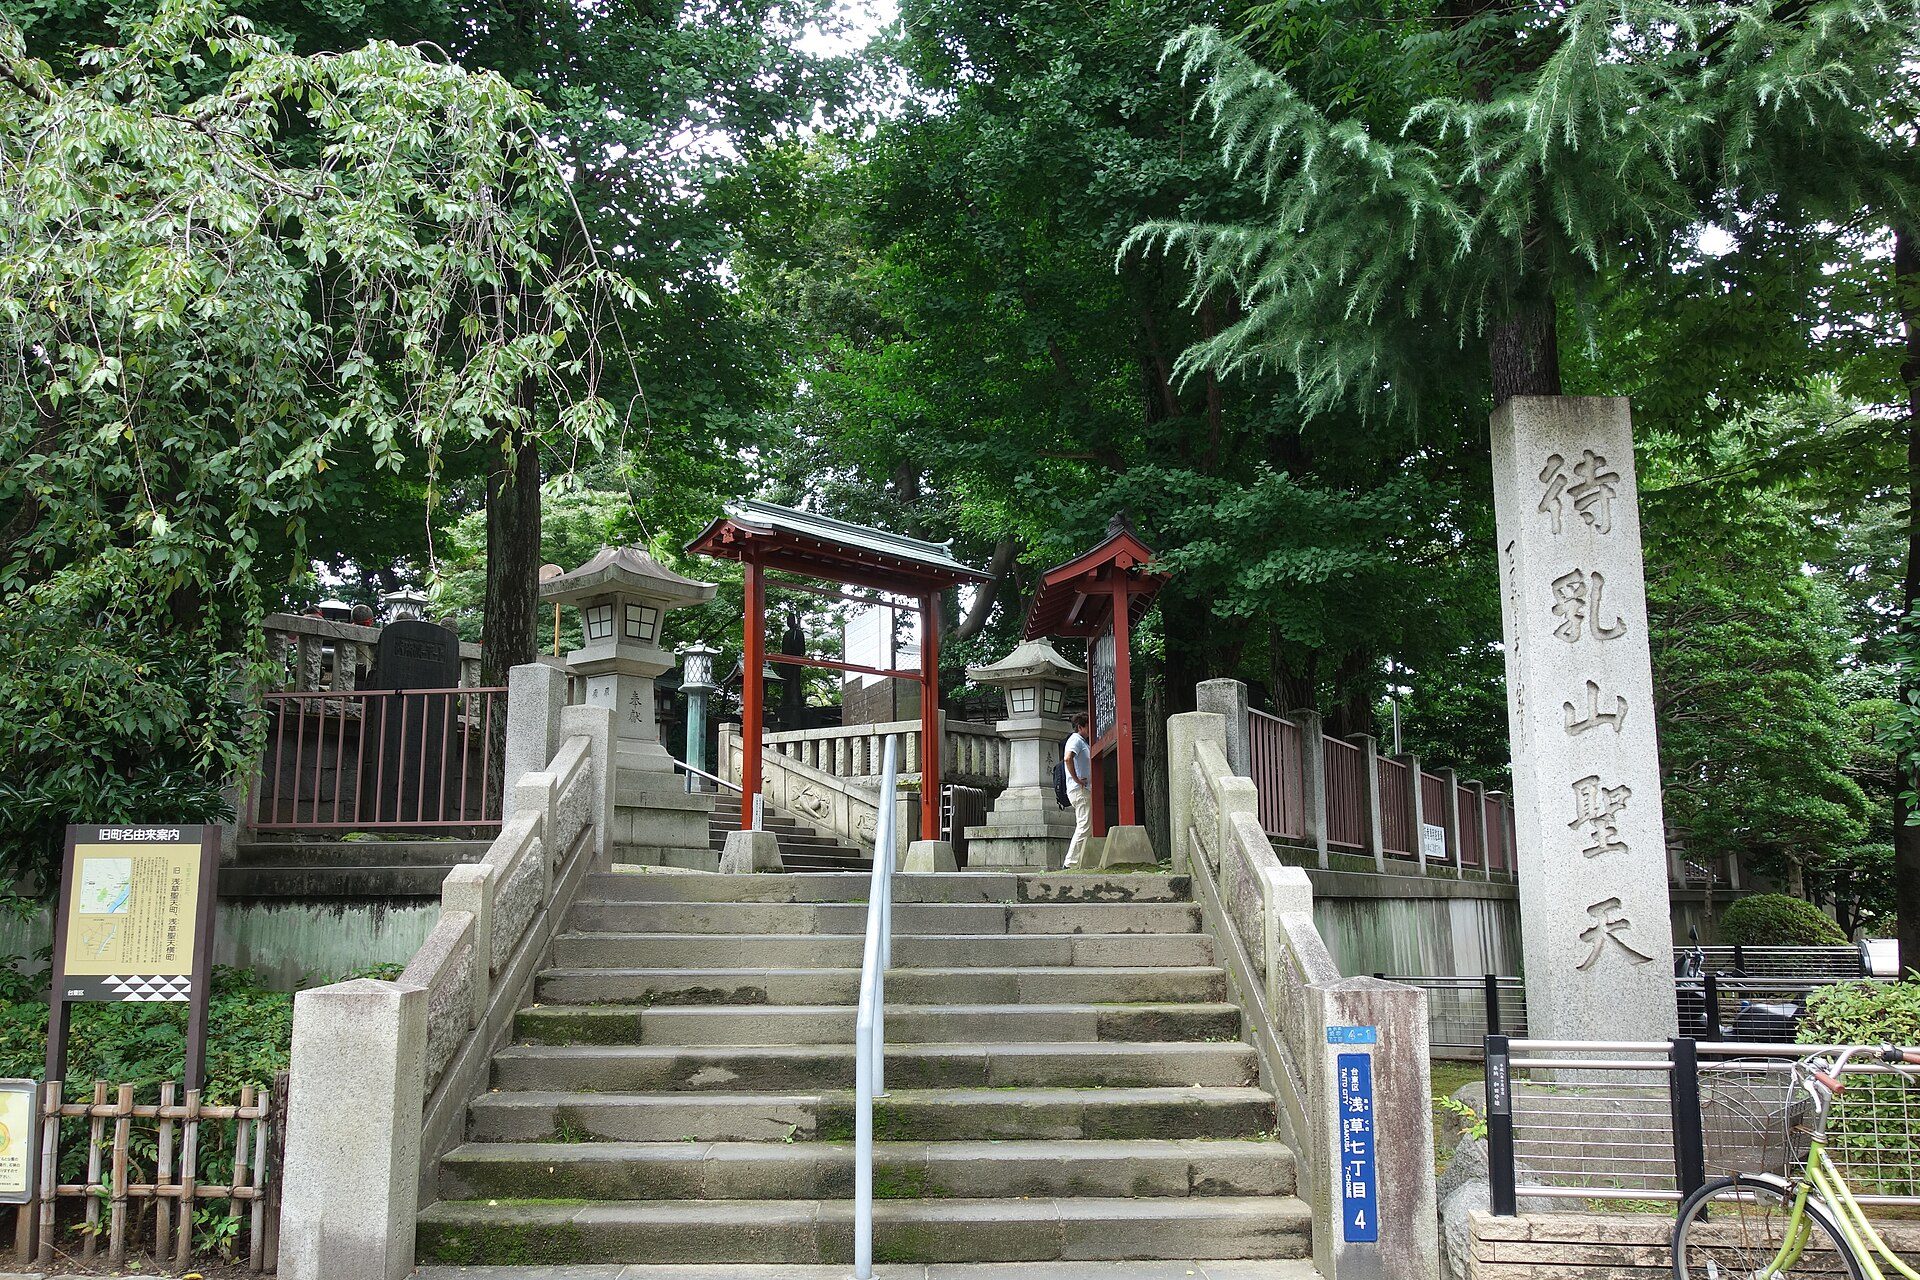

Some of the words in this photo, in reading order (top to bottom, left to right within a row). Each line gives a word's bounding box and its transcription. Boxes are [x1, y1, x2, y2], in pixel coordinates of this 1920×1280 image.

[1538, 449, 1654, 971] 待乳山聖天
[98, 828, 180, 841] 旧町名由来案内
[1348, 1029, 1372, 1040] 4-1
[1350, 1067, 1360, 1092] 台東区
[1343, 1118, 1351, 1153] ASAKUSA
[1348, 1096, 1366, 1198] 浅草七丁目
[1344, 1166, 1352, 1199] 7-CHOME
[1354, 1209, 1367, 1230] 4
